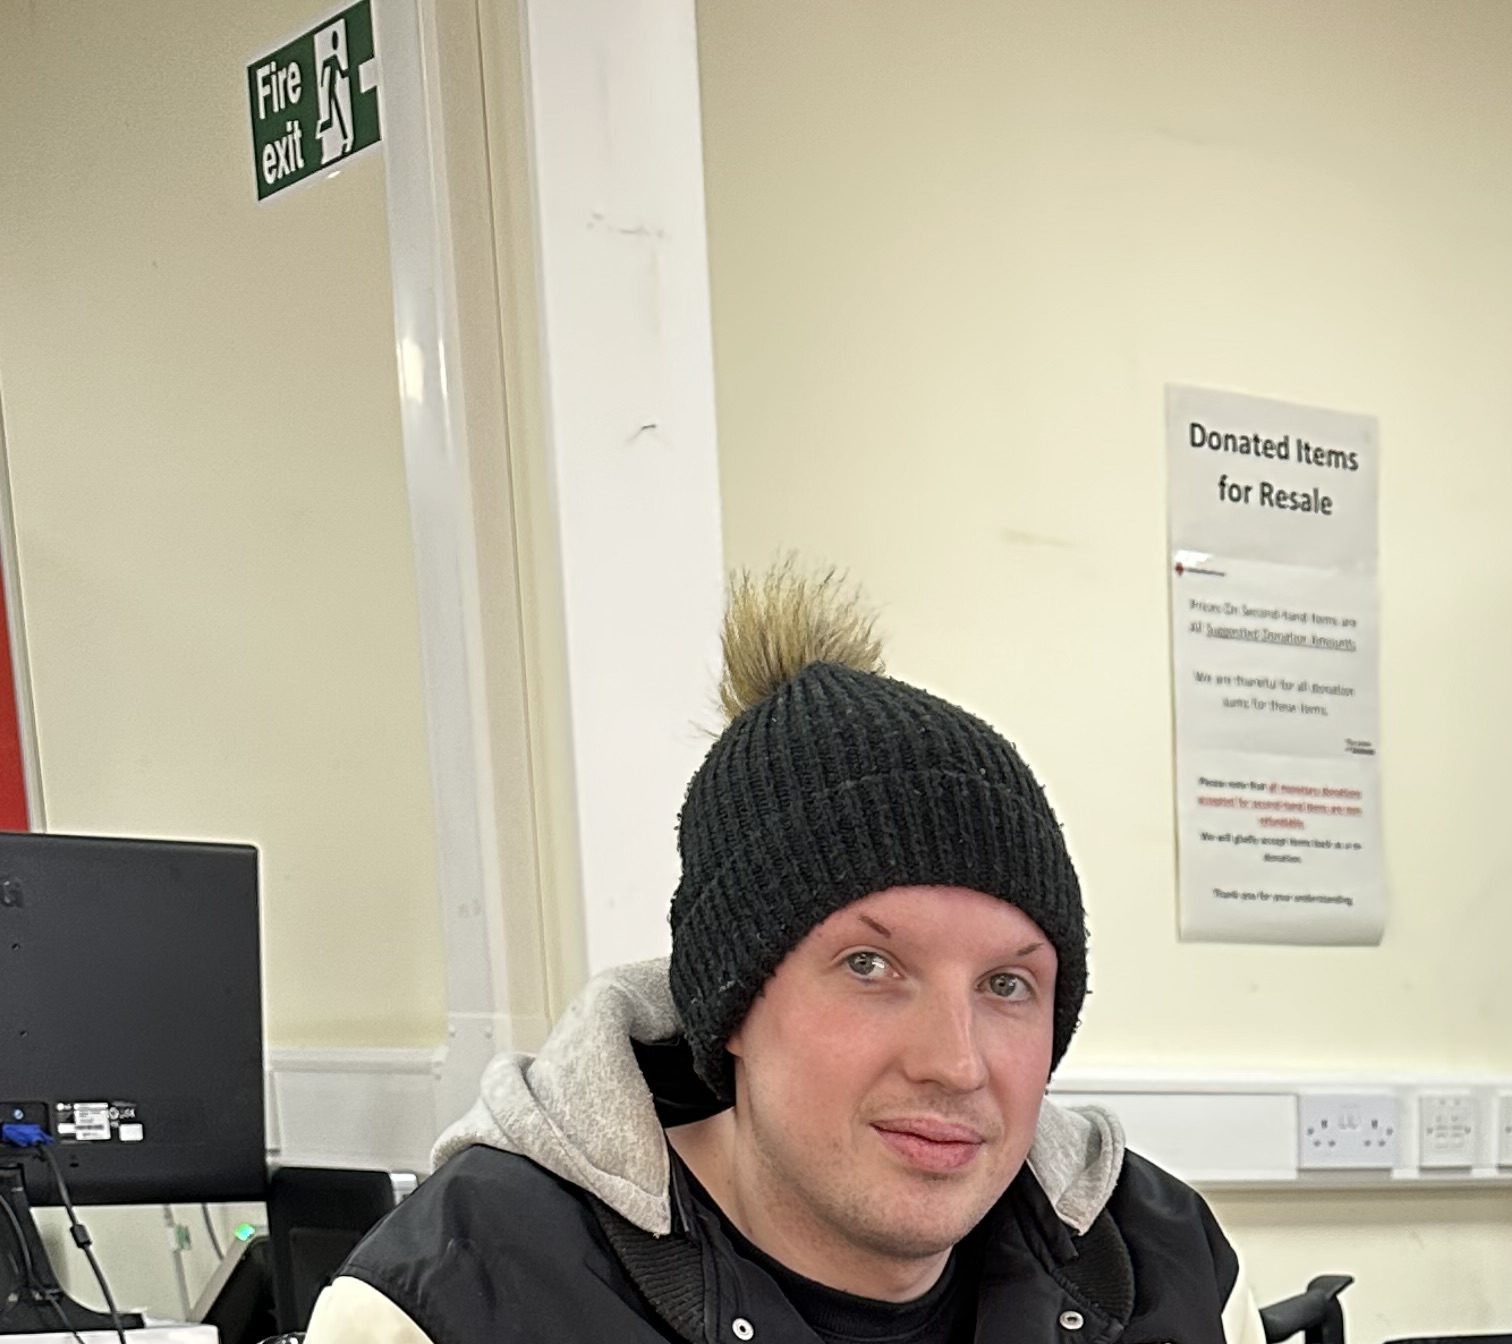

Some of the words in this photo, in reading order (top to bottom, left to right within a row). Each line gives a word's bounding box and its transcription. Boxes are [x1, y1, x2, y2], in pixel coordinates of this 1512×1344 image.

[256, 61, 301, 120] Fire
[262, 120, 304, 184] exit
[1190, 422, 1289, 461] Donated
[1297, 438, 1359, 471] Items
[1218, 474, 1253, 504] for
[1260, 481, 1333, 515] Resale
